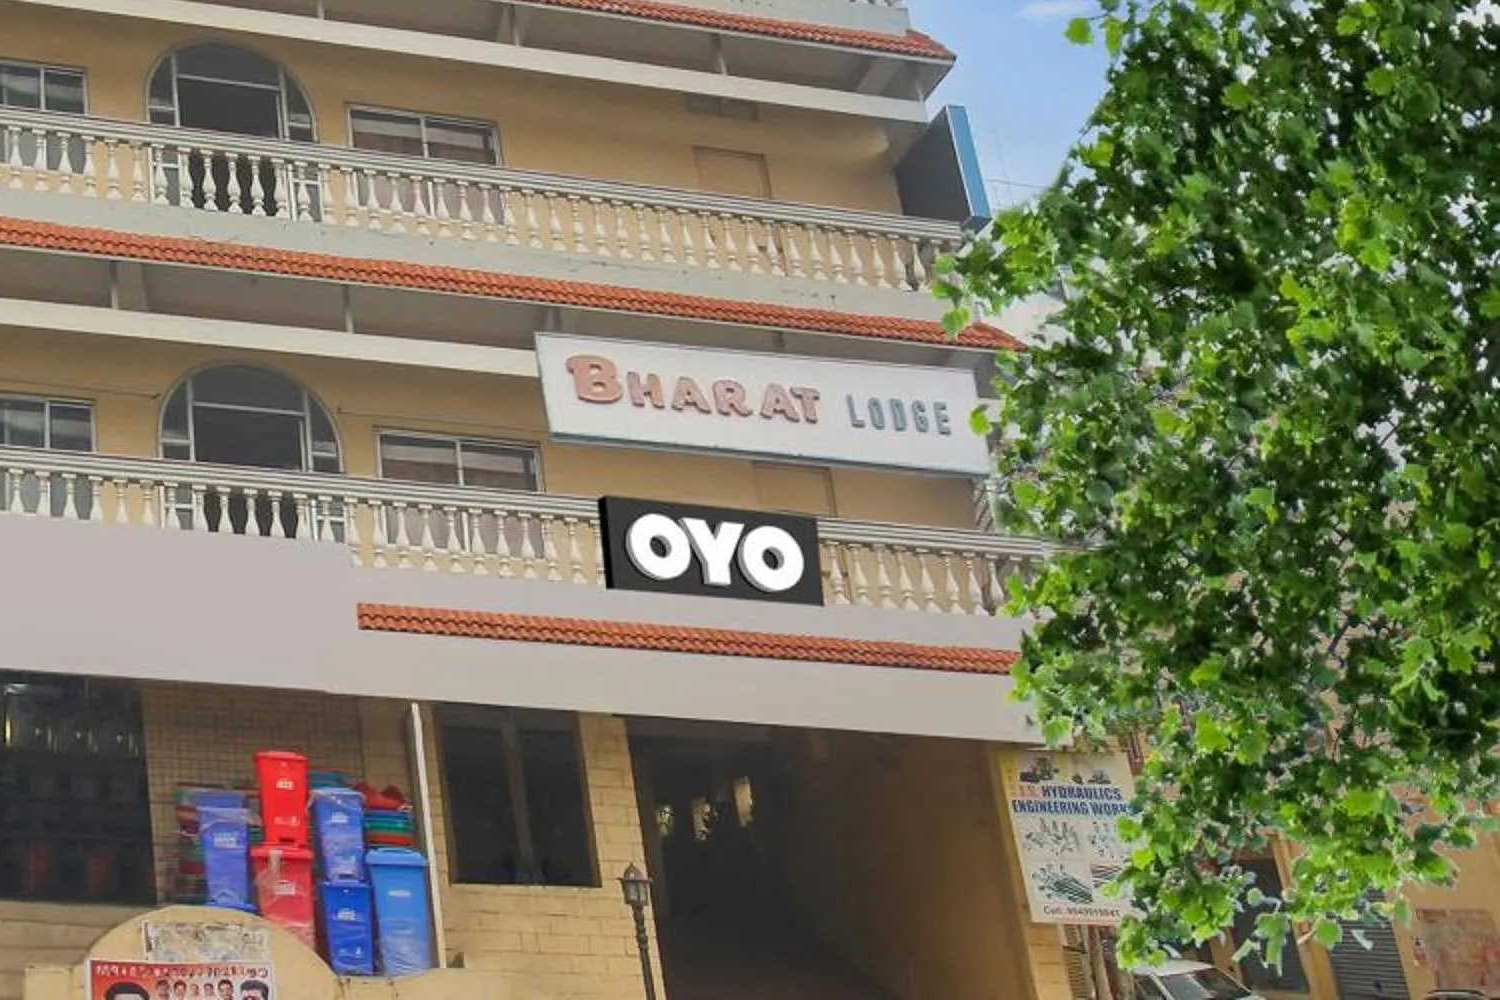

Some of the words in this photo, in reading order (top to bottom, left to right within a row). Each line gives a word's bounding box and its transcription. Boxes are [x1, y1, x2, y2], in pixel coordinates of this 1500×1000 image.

[566, 354, 821, 425] BHARAT
[846, 394, 952, 435] LODGE
[625, 512, 804, 593] OYO
[1011, 799, 1089, 815] ENGINEERING
[1041, 785, 1122, 800] HYDRAULICS
